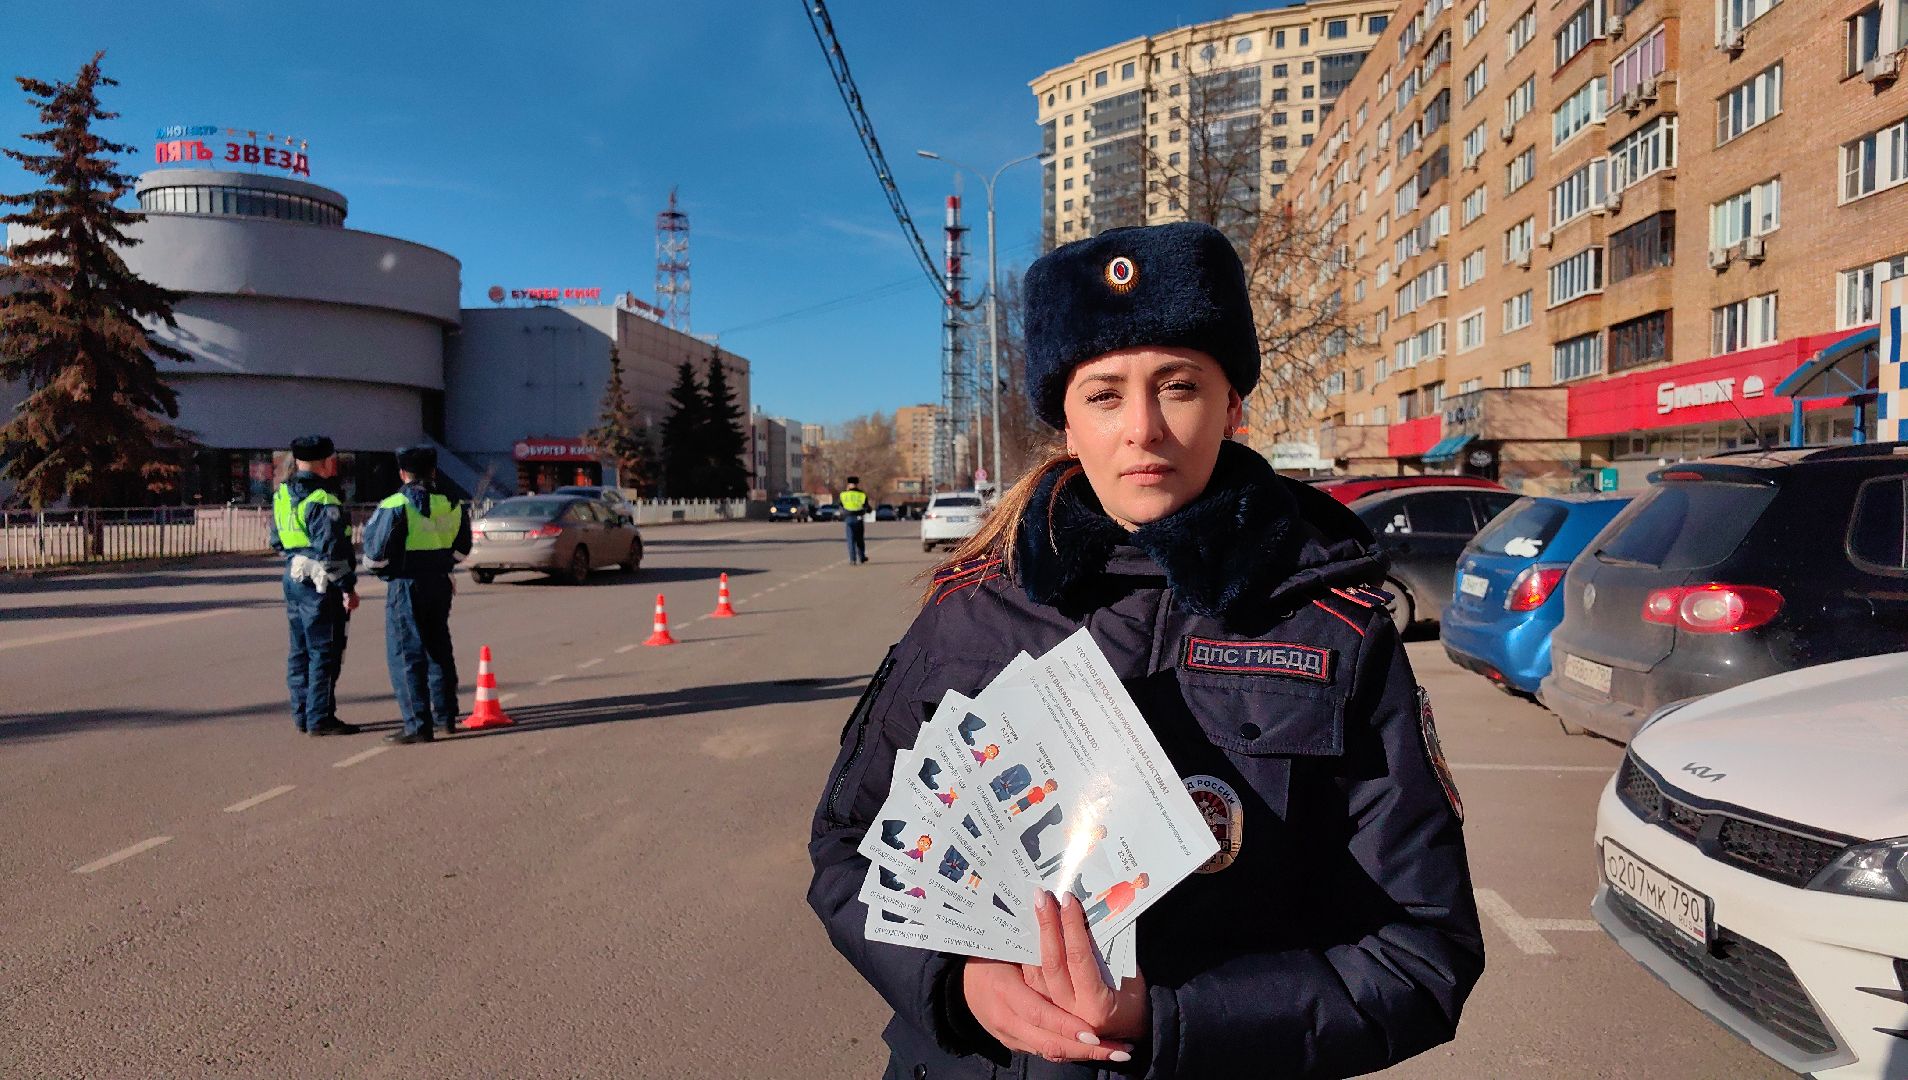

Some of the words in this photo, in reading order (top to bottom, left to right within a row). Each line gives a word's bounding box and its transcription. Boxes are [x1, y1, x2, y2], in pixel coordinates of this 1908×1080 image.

[156, 139, 213, 164] ПЯТЬ
[225, 143, 310, 176] ЗВЕЗД
[1193, 645, 1239, 664] ДПС
[1245, 649, 1320, 673] ГИБДД
[1197, 780, 1235, 804] РОССИИ
[1671, 885, 1699, 922] 790
